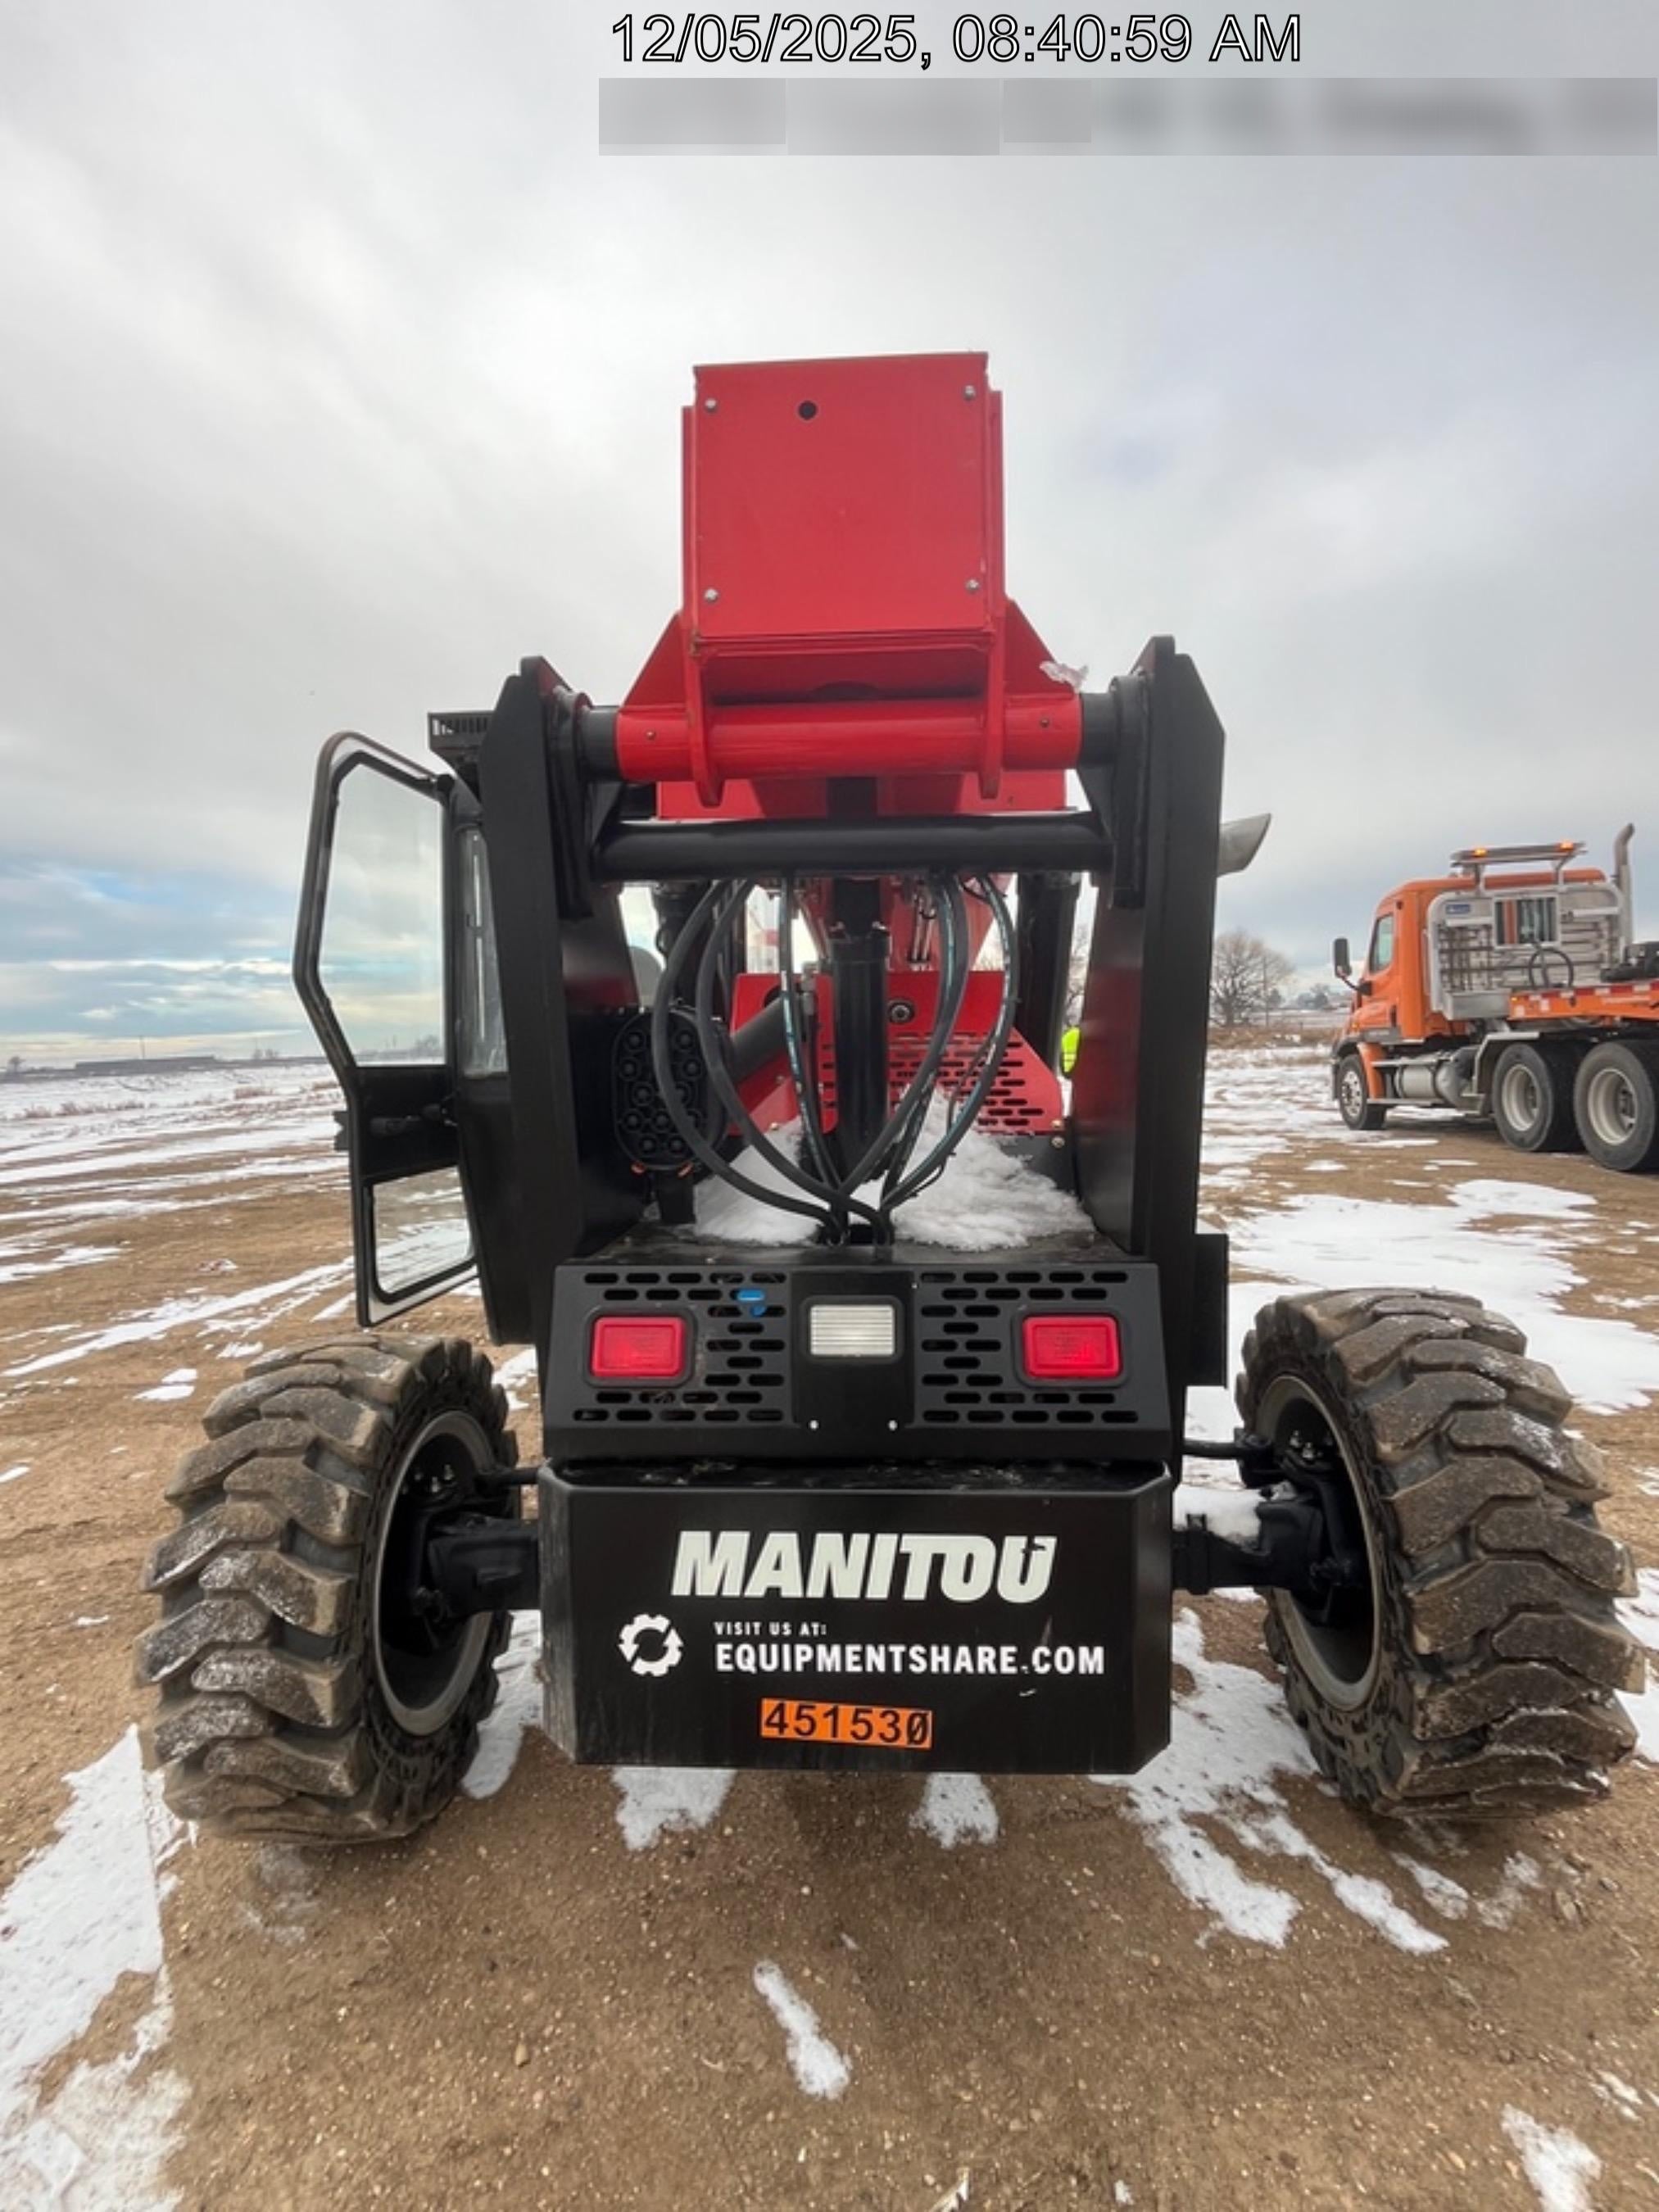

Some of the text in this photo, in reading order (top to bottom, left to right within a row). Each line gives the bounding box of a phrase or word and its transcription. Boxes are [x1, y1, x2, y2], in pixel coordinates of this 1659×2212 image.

[671, 1530, 1058, 1603] MANITOU
[714, 1621, 827, 1636] VISIT US AT:
[715, 1643, 1105, 1675] EQUIPMENTSHARE.COM
[764, 1702, 928, 1745] 451530
